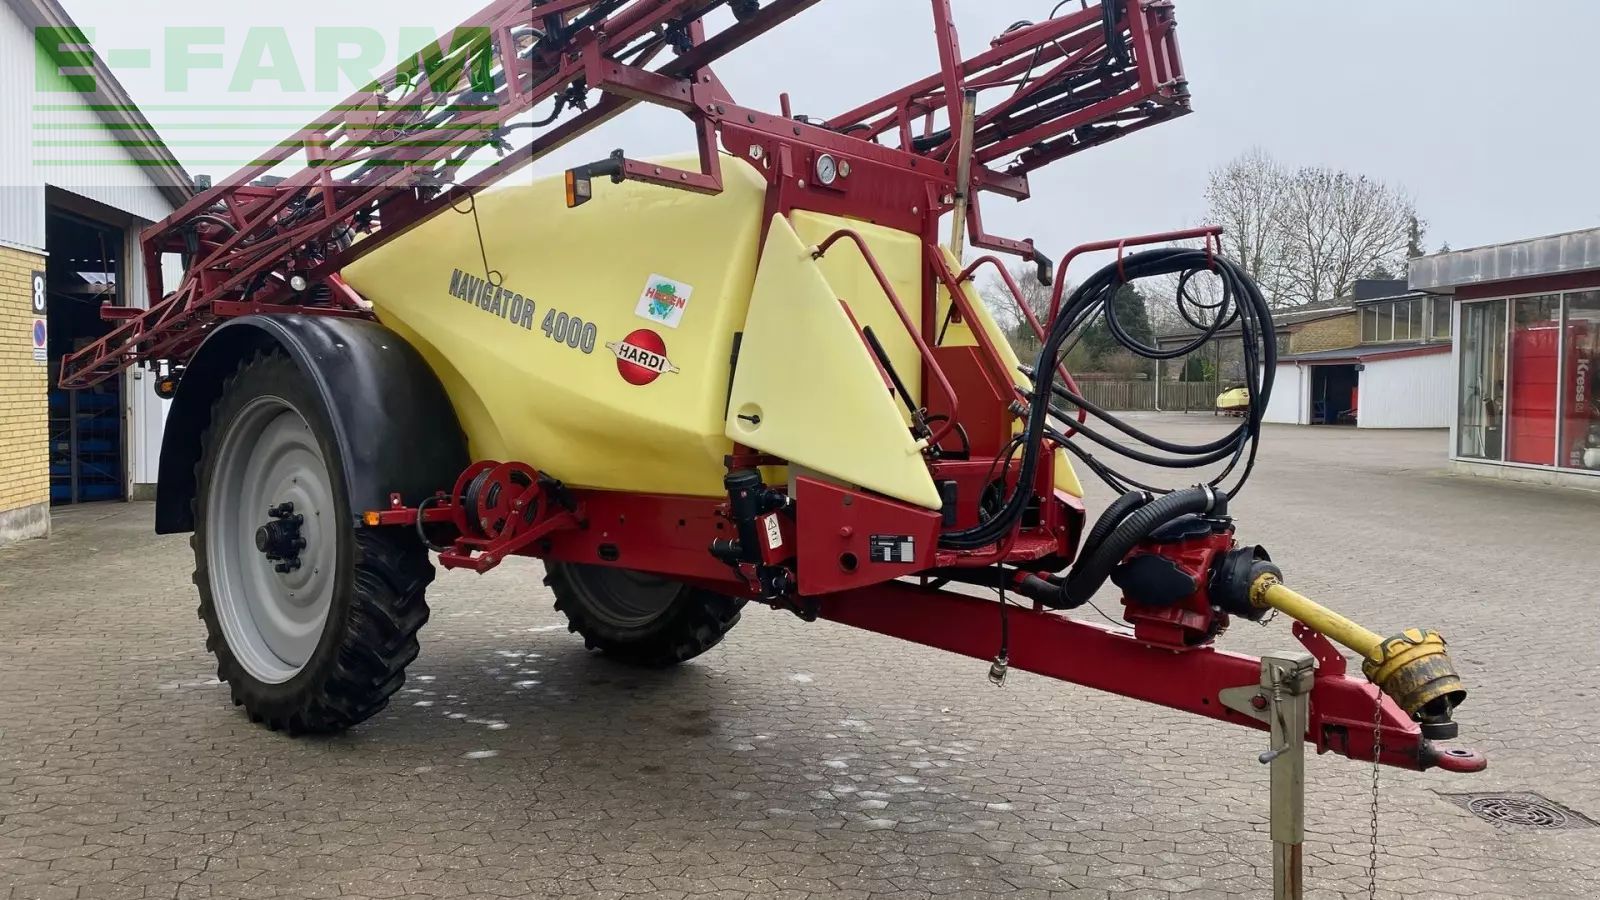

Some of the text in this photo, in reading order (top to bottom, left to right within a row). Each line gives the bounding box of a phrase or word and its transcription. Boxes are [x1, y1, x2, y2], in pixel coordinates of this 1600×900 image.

[34, 276, 45, 311] 8
[449, 268, 597, 355] NAVIGATOR 4000
[619, 344, 665, 371] HARDI
[1576, 359, 1589, 401] Kress
